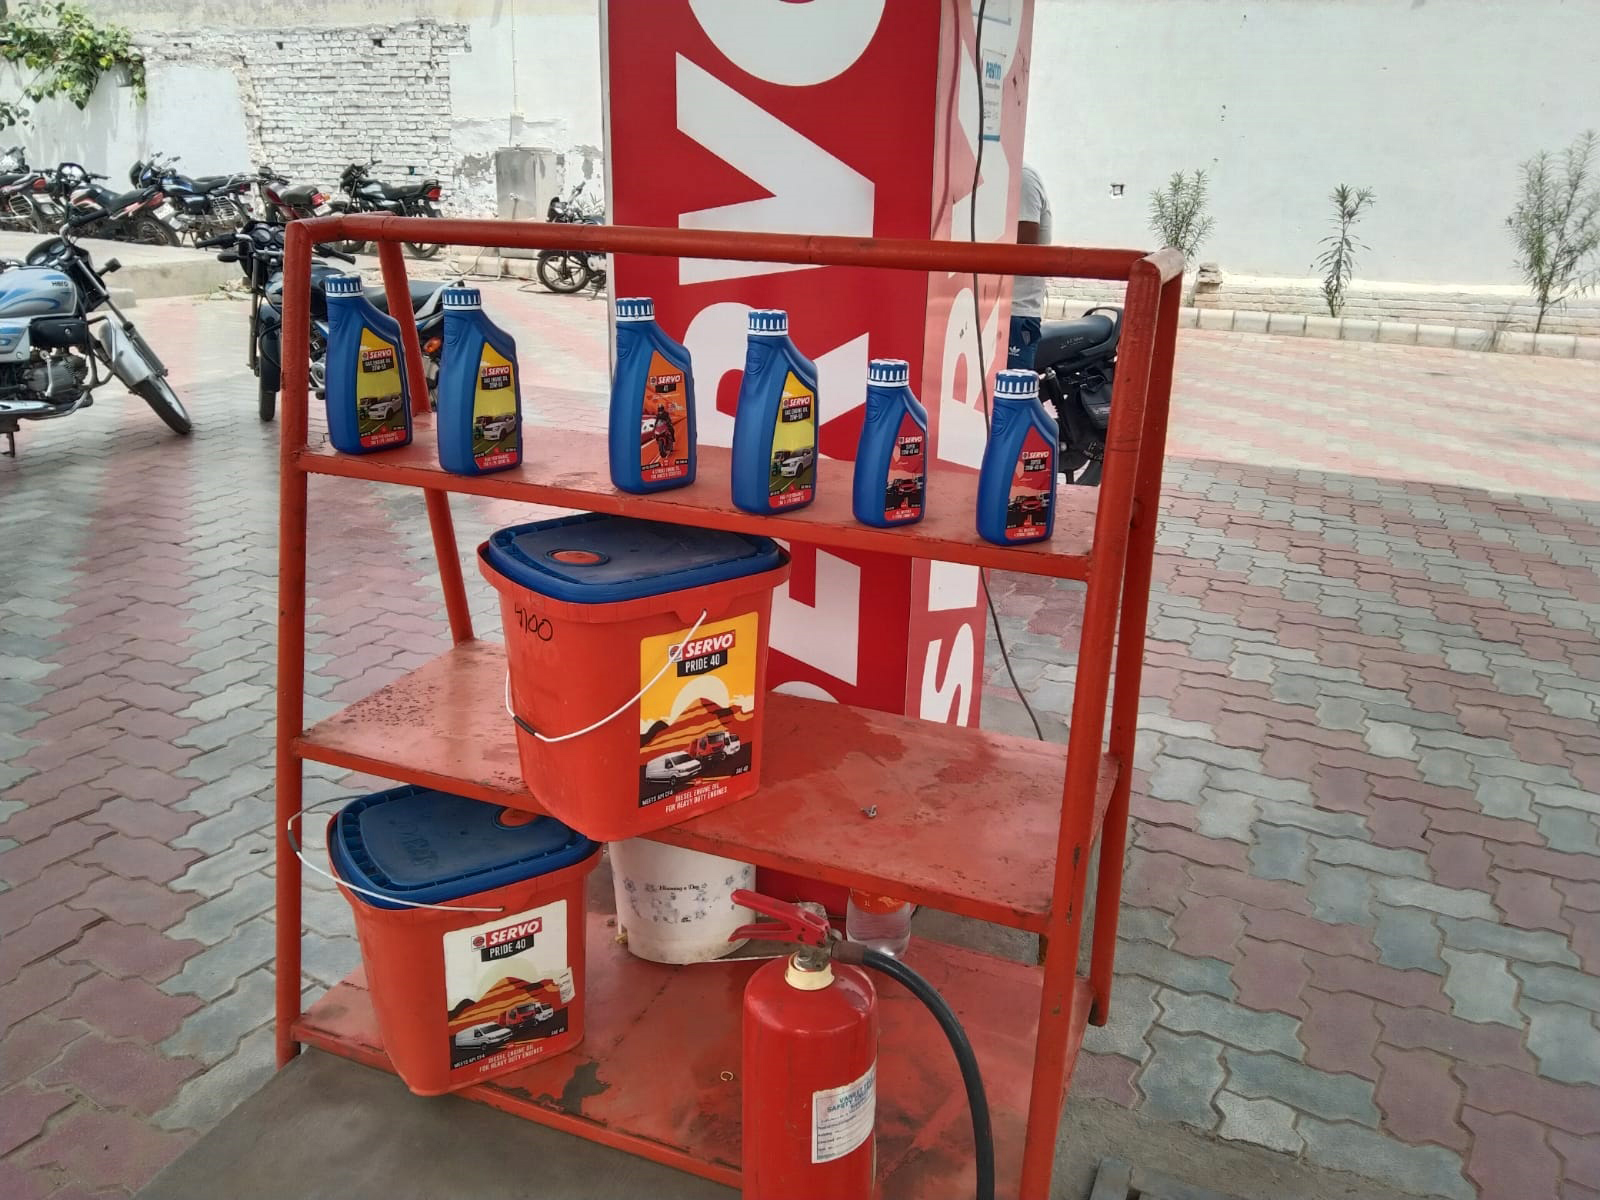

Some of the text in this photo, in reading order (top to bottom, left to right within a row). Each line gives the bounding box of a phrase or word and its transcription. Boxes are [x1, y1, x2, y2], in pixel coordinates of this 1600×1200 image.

[370, 349, 392, 359] SERVO
[489, 366, 510, 376] SERVO
[658, 375, 681, 385] SERVO
[789, 396, 811, 407] SERVO
[905, 435, 923, 444] SERVO
[1028, 451, 1049, 460] SERVO
[685, 633, 733, 658] SERVO
[685, 653, 721, 673] PRIDE 40
[642, 796, 657, 806] MEETS
[665, 786, 728, 814] FOR HEAVY DUTY ENGINES
[675, 793, 693, 803] DIESEL
[693, 786, 711, 796] ENGINE
[489, 921, 539, 946] SERVO
[489, 938, 526, 958] PRIDE 40
[479, 1046, 543, 1073] FOR HEAVY DUTY ENGINES
[488, 1043, 534, 1063] DIESEL ENGINE OIL
